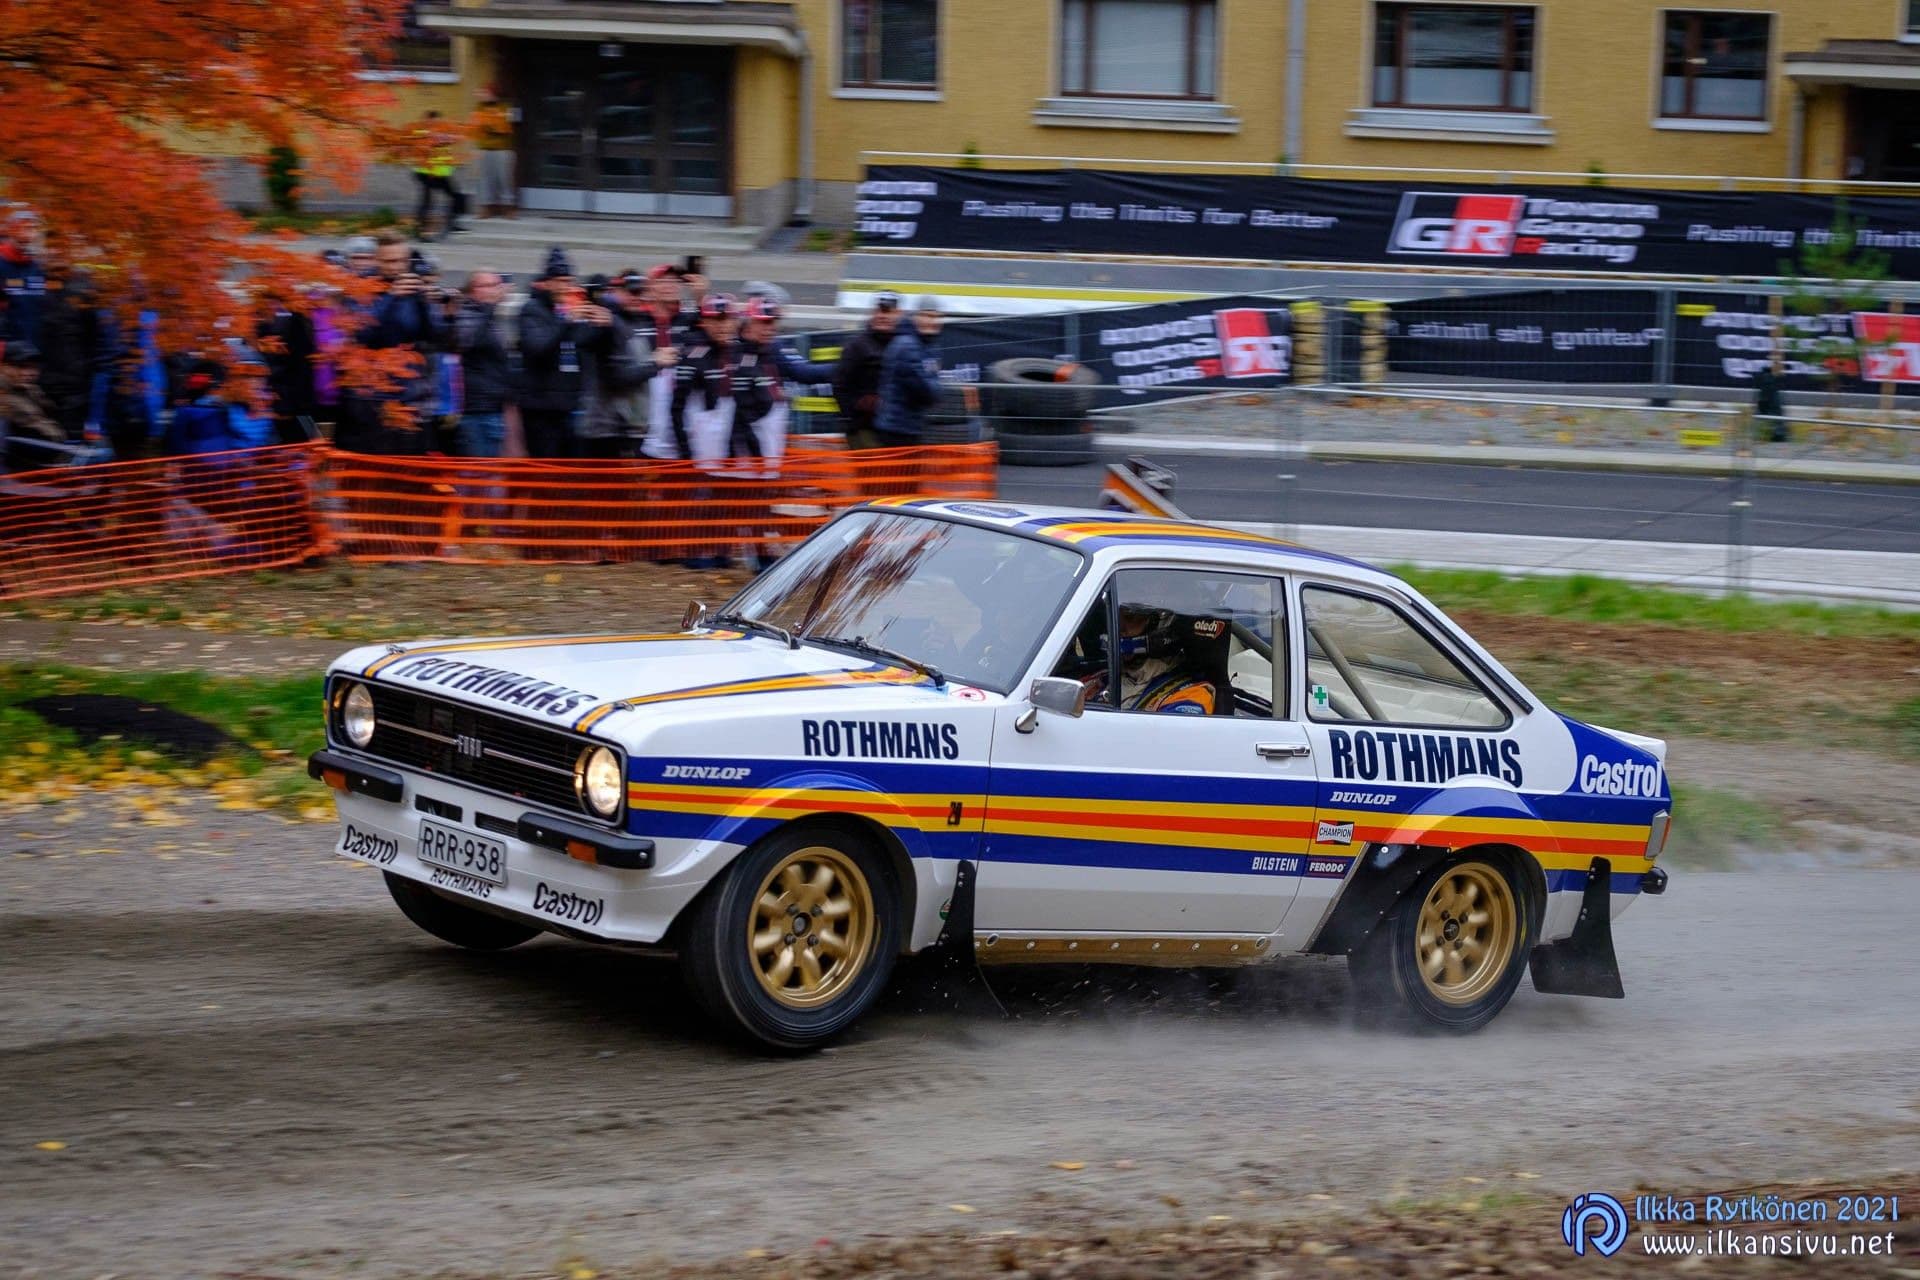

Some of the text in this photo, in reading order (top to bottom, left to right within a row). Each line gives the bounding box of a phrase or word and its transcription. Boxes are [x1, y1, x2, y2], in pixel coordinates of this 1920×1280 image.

[962, 200, 1338, 228] Pushing the limits for Better
[1396, 217, 1514, 250] GR
[1687, 224, 1795, 247] Pushing
[1513, 237, 1638, 263] Racing
[393, 657, 599, 716] ROTHMANS
[802, 719, 960, 760] ROTHMANS
[661, 764, 752, 780] DUNLOP
[1328, 729, 1524, 788] ROTHMANS
[1580, 754, 1662, 798] Castrol
[1329, 791, 1397, 805] DUNLOP
[342, 823, 399, 865] Castrol
[1318, 826, 1352, 839] CHAMPION
[422, 826, 501, 876] RRR-938
[1251, 856, 1299, 872] BILSTEIN
[1309, 862, 1345, 873] FERODO
[430, 868, 494, 899] ROTHMANS
[533, 881, 604, 926] Castrol
